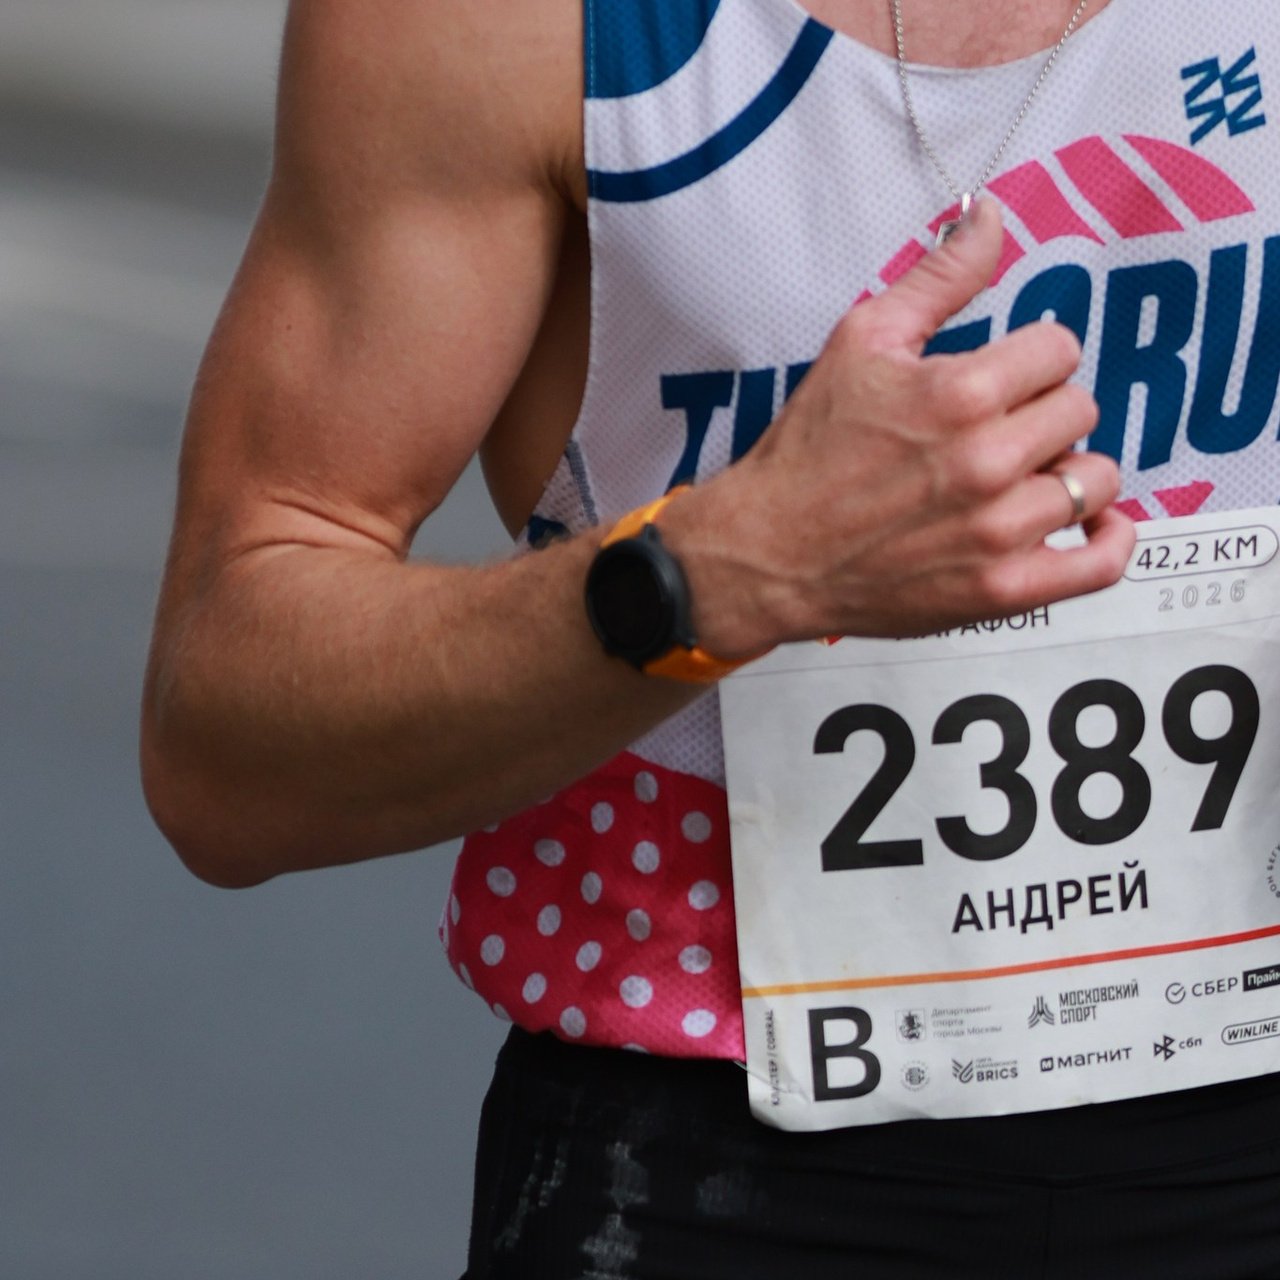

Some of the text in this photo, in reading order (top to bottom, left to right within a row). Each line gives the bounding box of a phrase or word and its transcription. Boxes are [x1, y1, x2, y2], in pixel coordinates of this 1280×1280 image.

[1136, 542, 1199, 570] 42,2
[1157, 579, 1246, 612] 2026
[813, 664, 1260, 872] 2389
[951, 859, 1149, 934] АНДРЕЙ
[1058, 978, 1139, 1007] МОСКОВСКИЙ
[1191, 976, 1238, 997] СБЕР
[1060, 1005, 1097, 1024] СПОРТ
[1227, 1021, 1279, 1041] WINLINE
[976, 1067, 1018, 1082] BRICS
